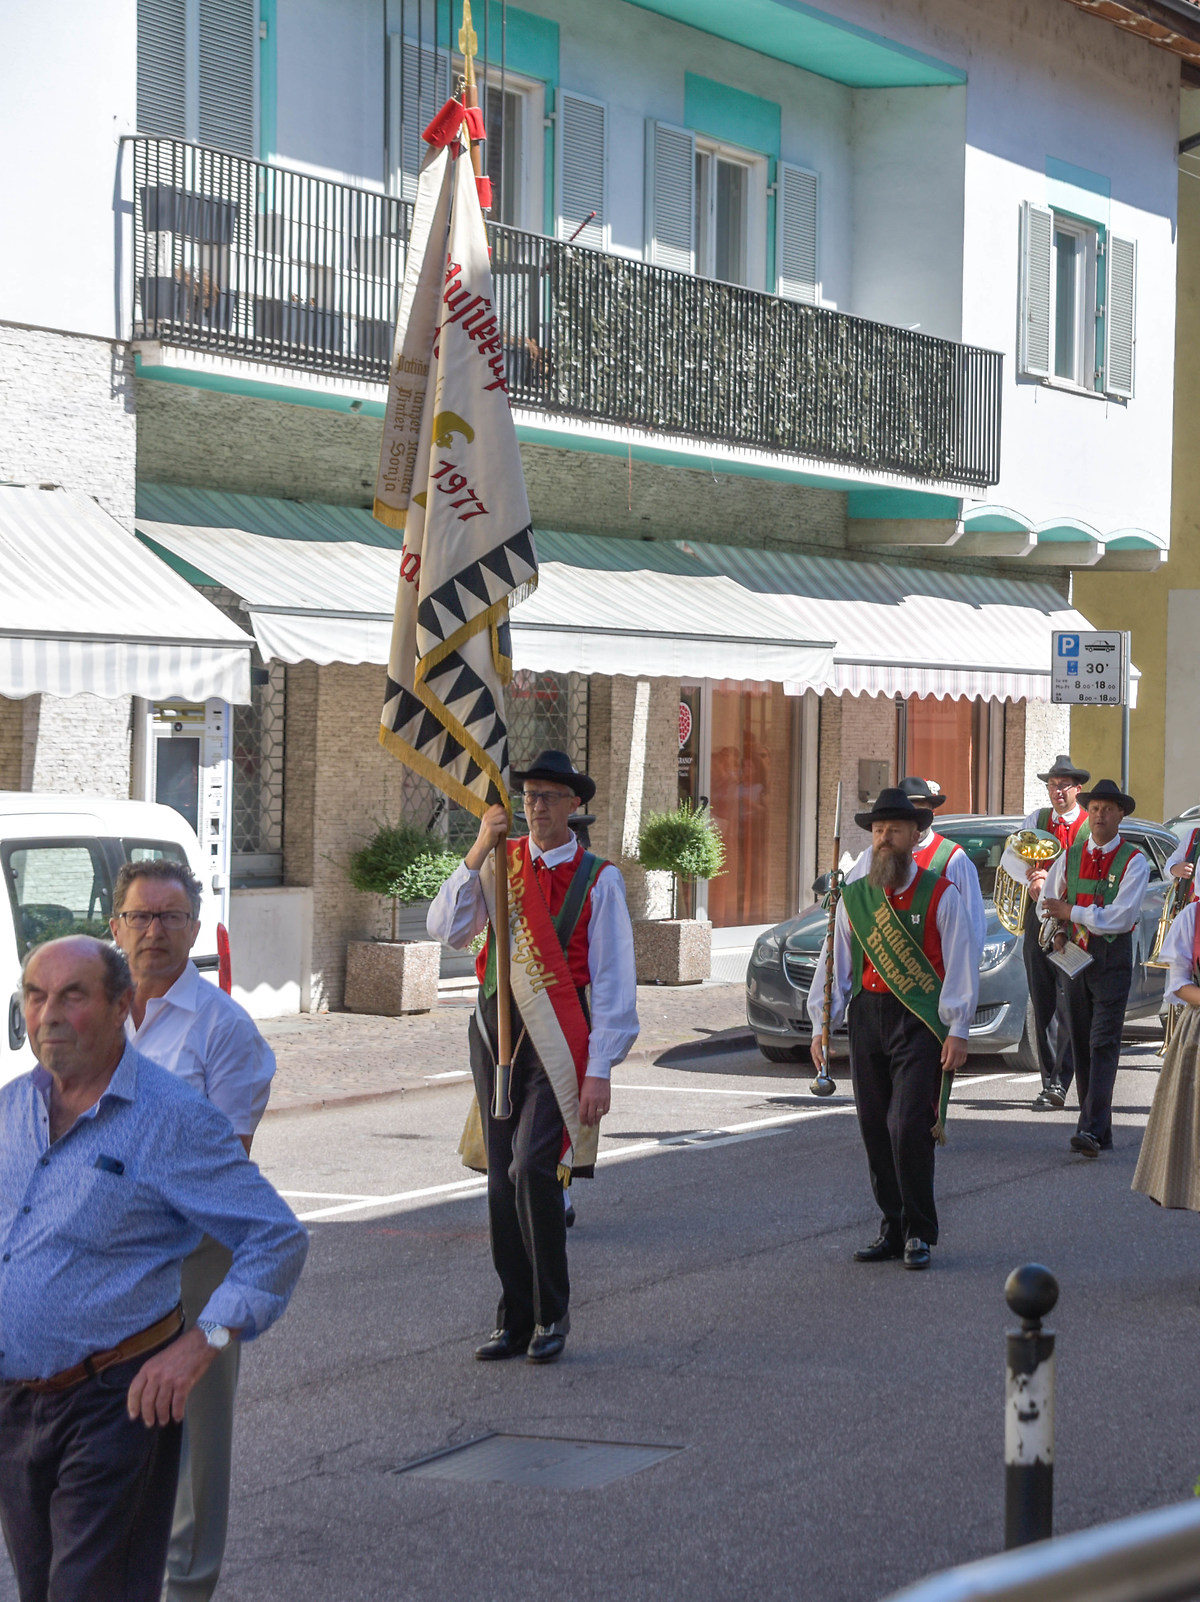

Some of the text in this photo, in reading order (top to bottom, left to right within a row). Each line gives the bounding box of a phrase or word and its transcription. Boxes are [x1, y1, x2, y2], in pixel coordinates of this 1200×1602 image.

[383, 386, 413, 493] Pinter Sonja
[430, 460, 489, 521] 1977
[1062, 637, 1075, 654] P
[508, 877, 560, 995] Branzoll
[866, 926, 917, 995] Branzoll
[872, 902, 936, 994] Musikkapelle
